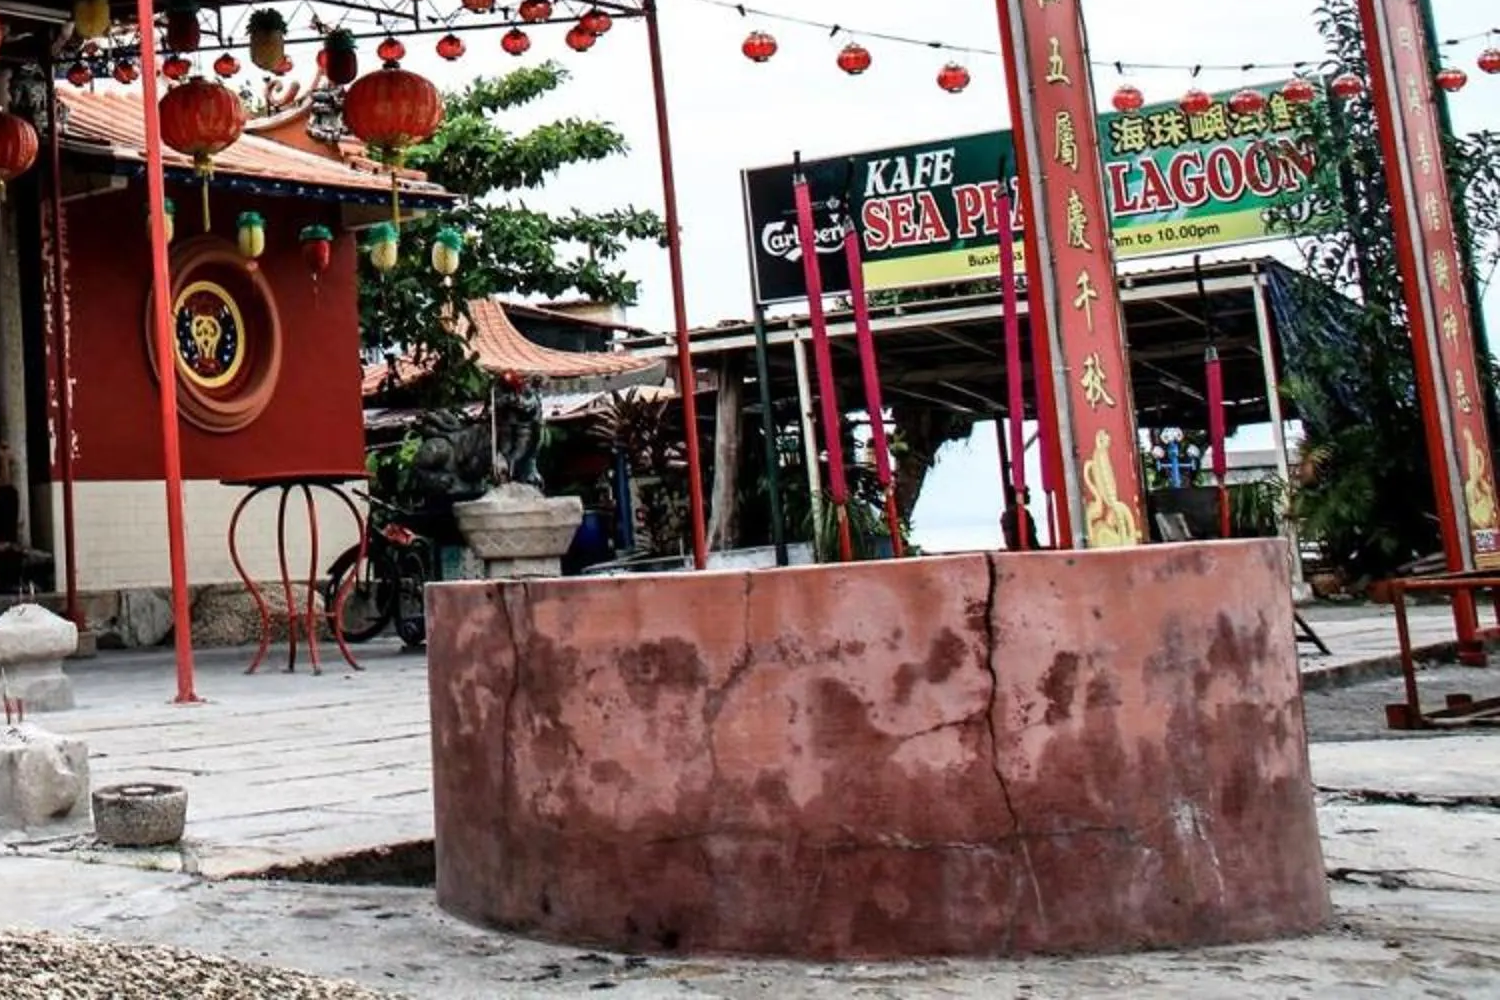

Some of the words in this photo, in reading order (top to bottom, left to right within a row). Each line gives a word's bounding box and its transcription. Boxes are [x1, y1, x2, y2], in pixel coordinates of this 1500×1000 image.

[861, 191, 949, 251] SEA
[1106, 137, 1318, 216] LAGOON
[864, 148, 956, 198] KAFE
[1137, 233, 1153, 245] to
[1157, 223, 1220, 241] 10.00pm
